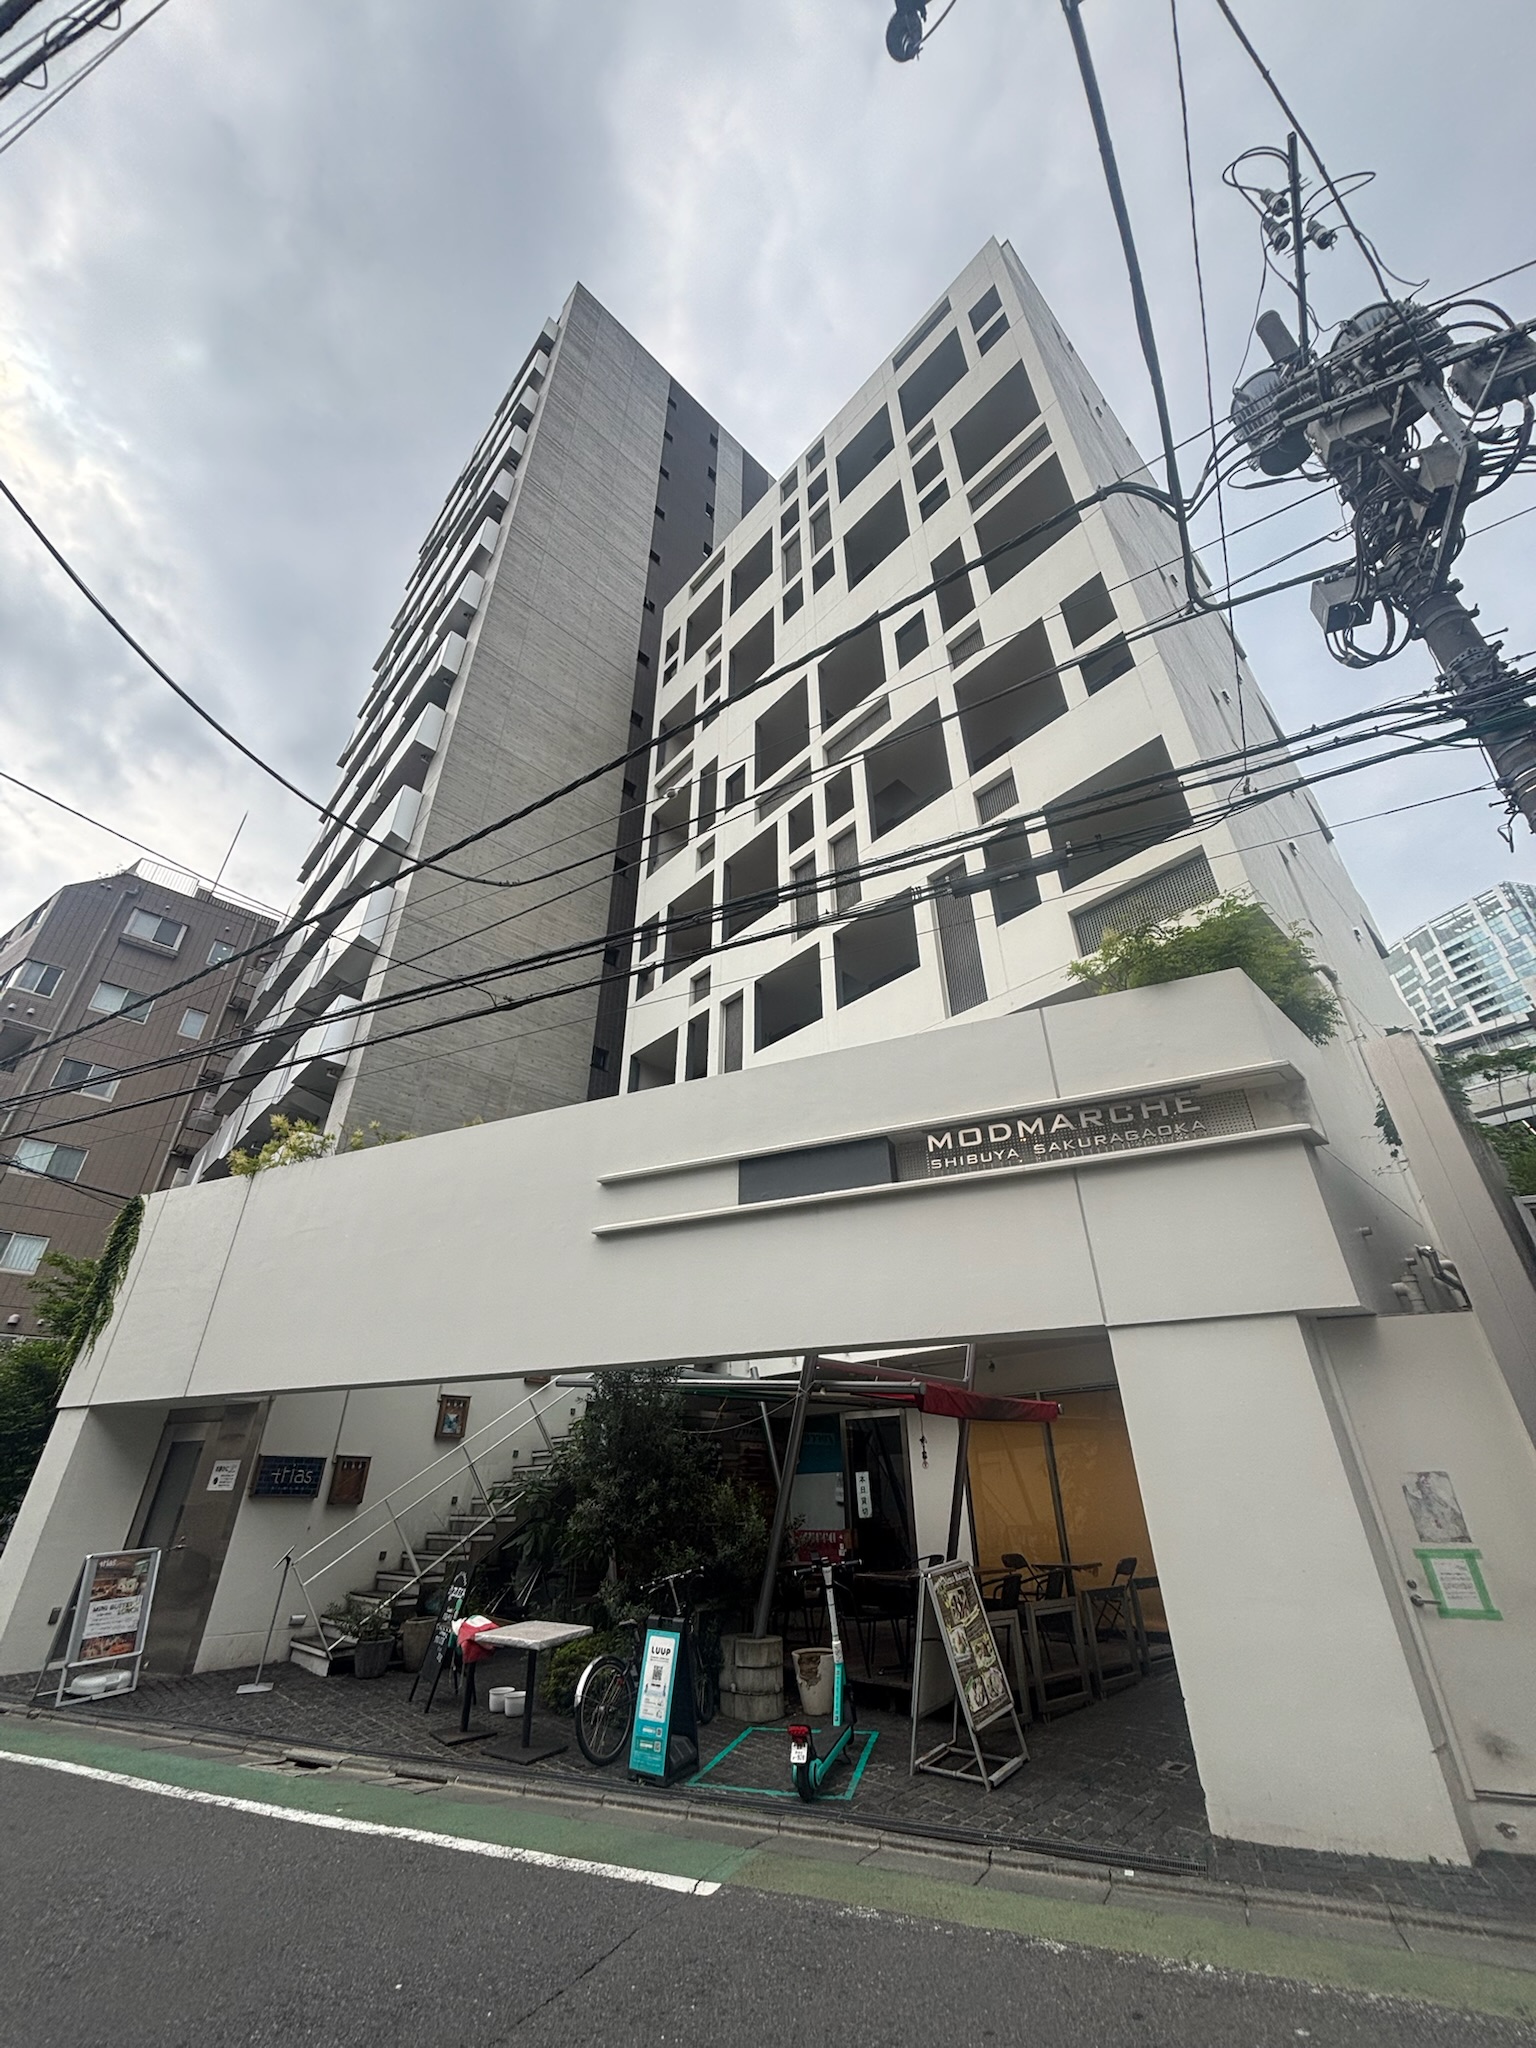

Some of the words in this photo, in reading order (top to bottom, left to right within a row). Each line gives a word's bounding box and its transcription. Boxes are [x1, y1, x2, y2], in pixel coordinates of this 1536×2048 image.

[927, 1096, 1202, 1151] MODMARCHE
[931, 1148, 1020, 1170] SHIBUYA
[1033, 1120, 1206, 1154] SAKURAGAOKA
[271, 1463, 314, 1485] trias
[651, 1645, 671, 1656] LUUP
